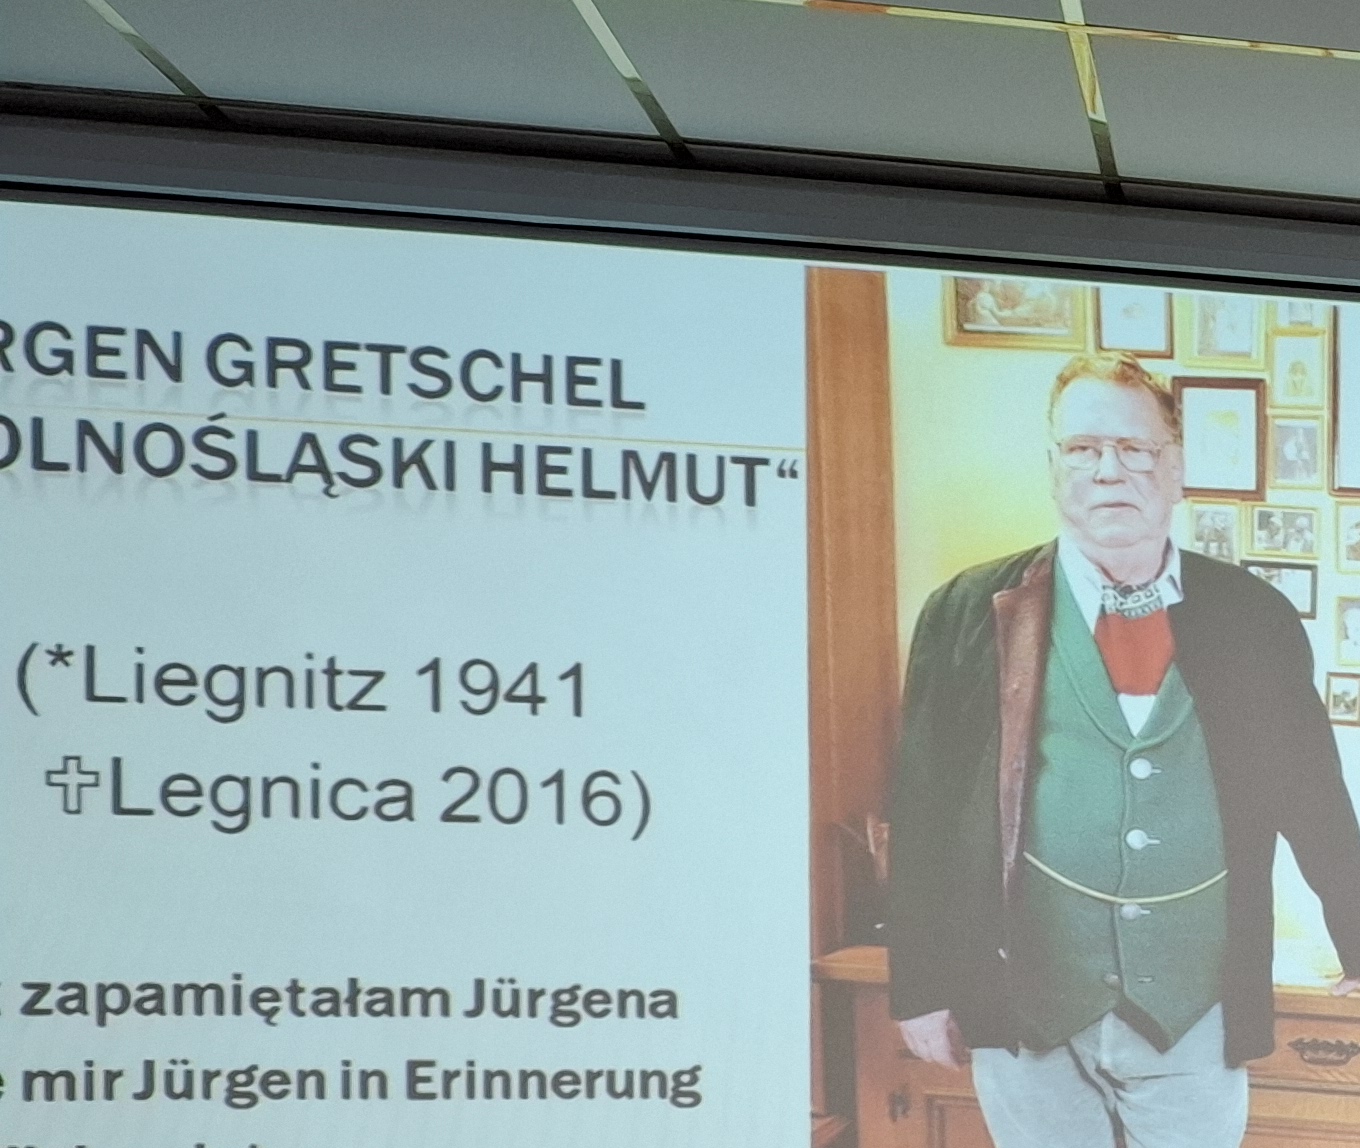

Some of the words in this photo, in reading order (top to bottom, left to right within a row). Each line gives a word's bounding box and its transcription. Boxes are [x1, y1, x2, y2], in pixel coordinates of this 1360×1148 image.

[205, 331, 647, 411] GRETSCHEL
[416, 656, 583, 718] 1941
[439, 765, 652, 842] 2016)
[19, 972, 451, 1029] zapamiętałam
[462, 977, 679, 1029] Jürgena
[22, 1059, 124, 1102] mir
[131, 1058, 326, 1110] Jürgen
[341, 1059, 389, 1101] in
[405, 1059, 703, 1109] Erinnerung
